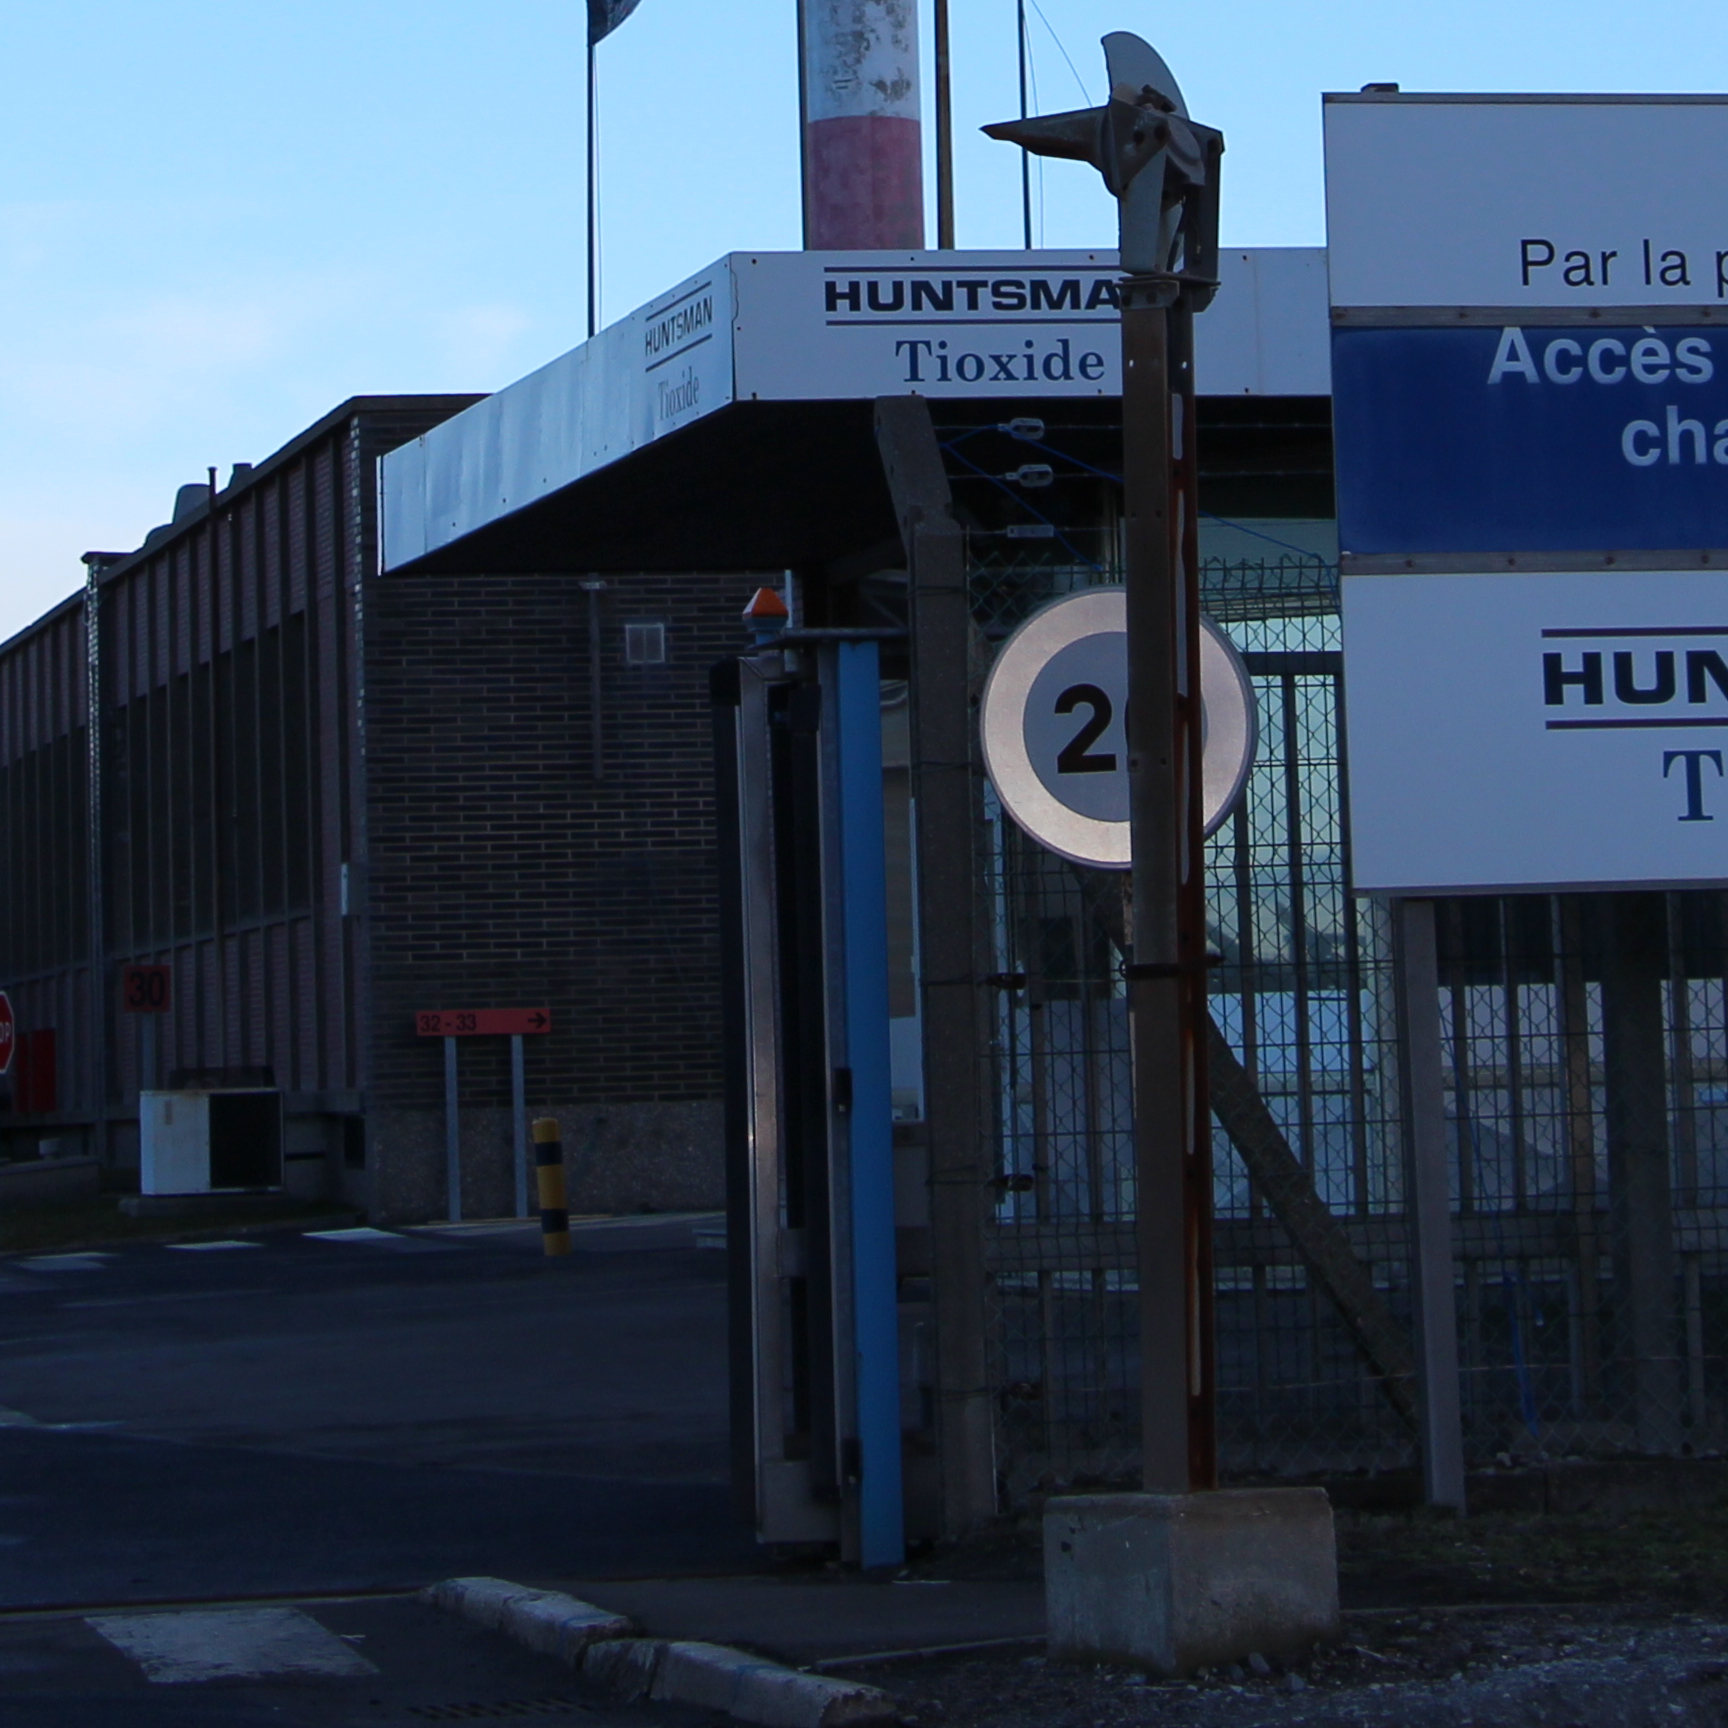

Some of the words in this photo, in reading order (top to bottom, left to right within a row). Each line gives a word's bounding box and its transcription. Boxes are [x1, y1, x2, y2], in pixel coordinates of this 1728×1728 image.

[1520, 238, 1618, 286] Par
[1643, 238, 1691, 286] la
[825, 278, 1120, 312] HUNTSMA
[645, 295, 713, 356] HUNTSMAN
[895, 338, 1105, 383] Tioxide
[1487, 325, 1714, 385] Accès
[658, 366, 700, 420] Tioxide
[1054, 683, 1130, 775] 2
[129, 970, 165, 1007] 30
[419, 1015, 441, 1032] 32
[456, 1014, 477, 1031] 33
